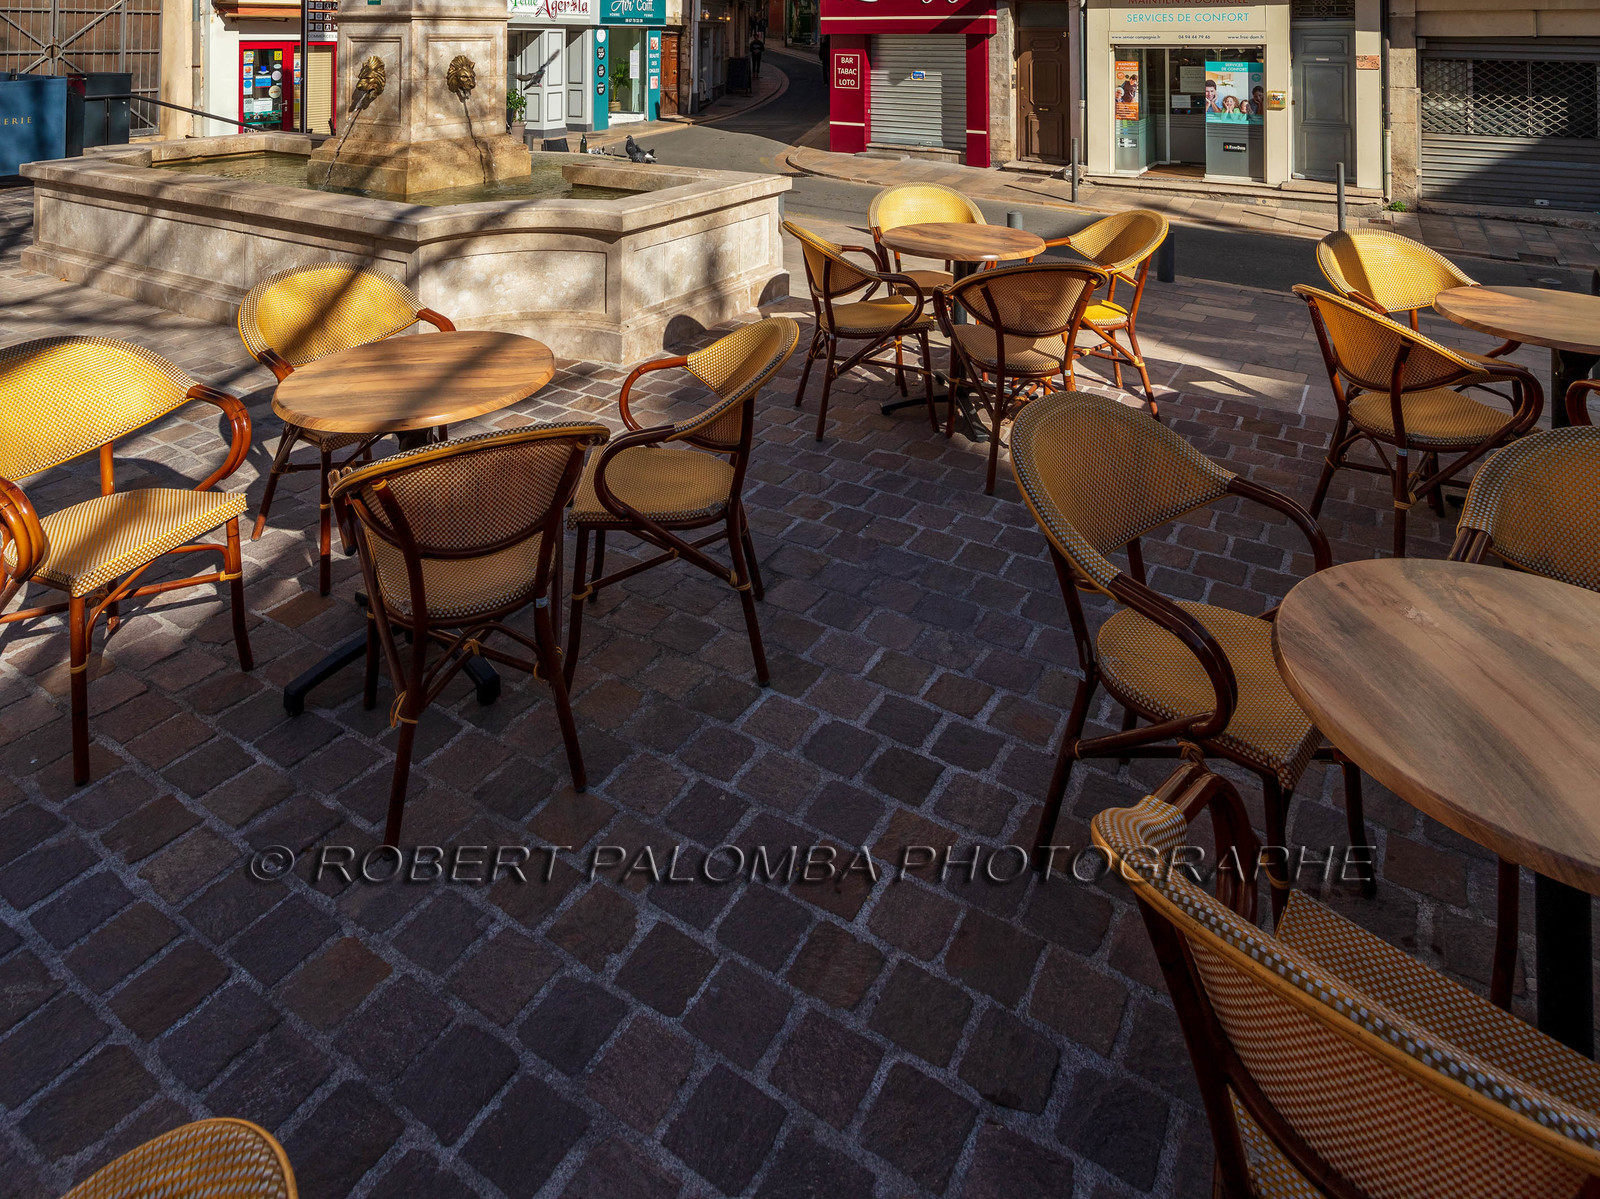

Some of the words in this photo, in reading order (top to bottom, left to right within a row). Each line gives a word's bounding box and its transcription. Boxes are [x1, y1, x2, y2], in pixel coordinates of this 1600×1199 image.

[1126, 13, 1174, 23] SERVICES
[1177, 13, 1191, 22] DE
[1194, 12, 1249, 22] CONFORT
[837, 68, 857, 76] TABAC
